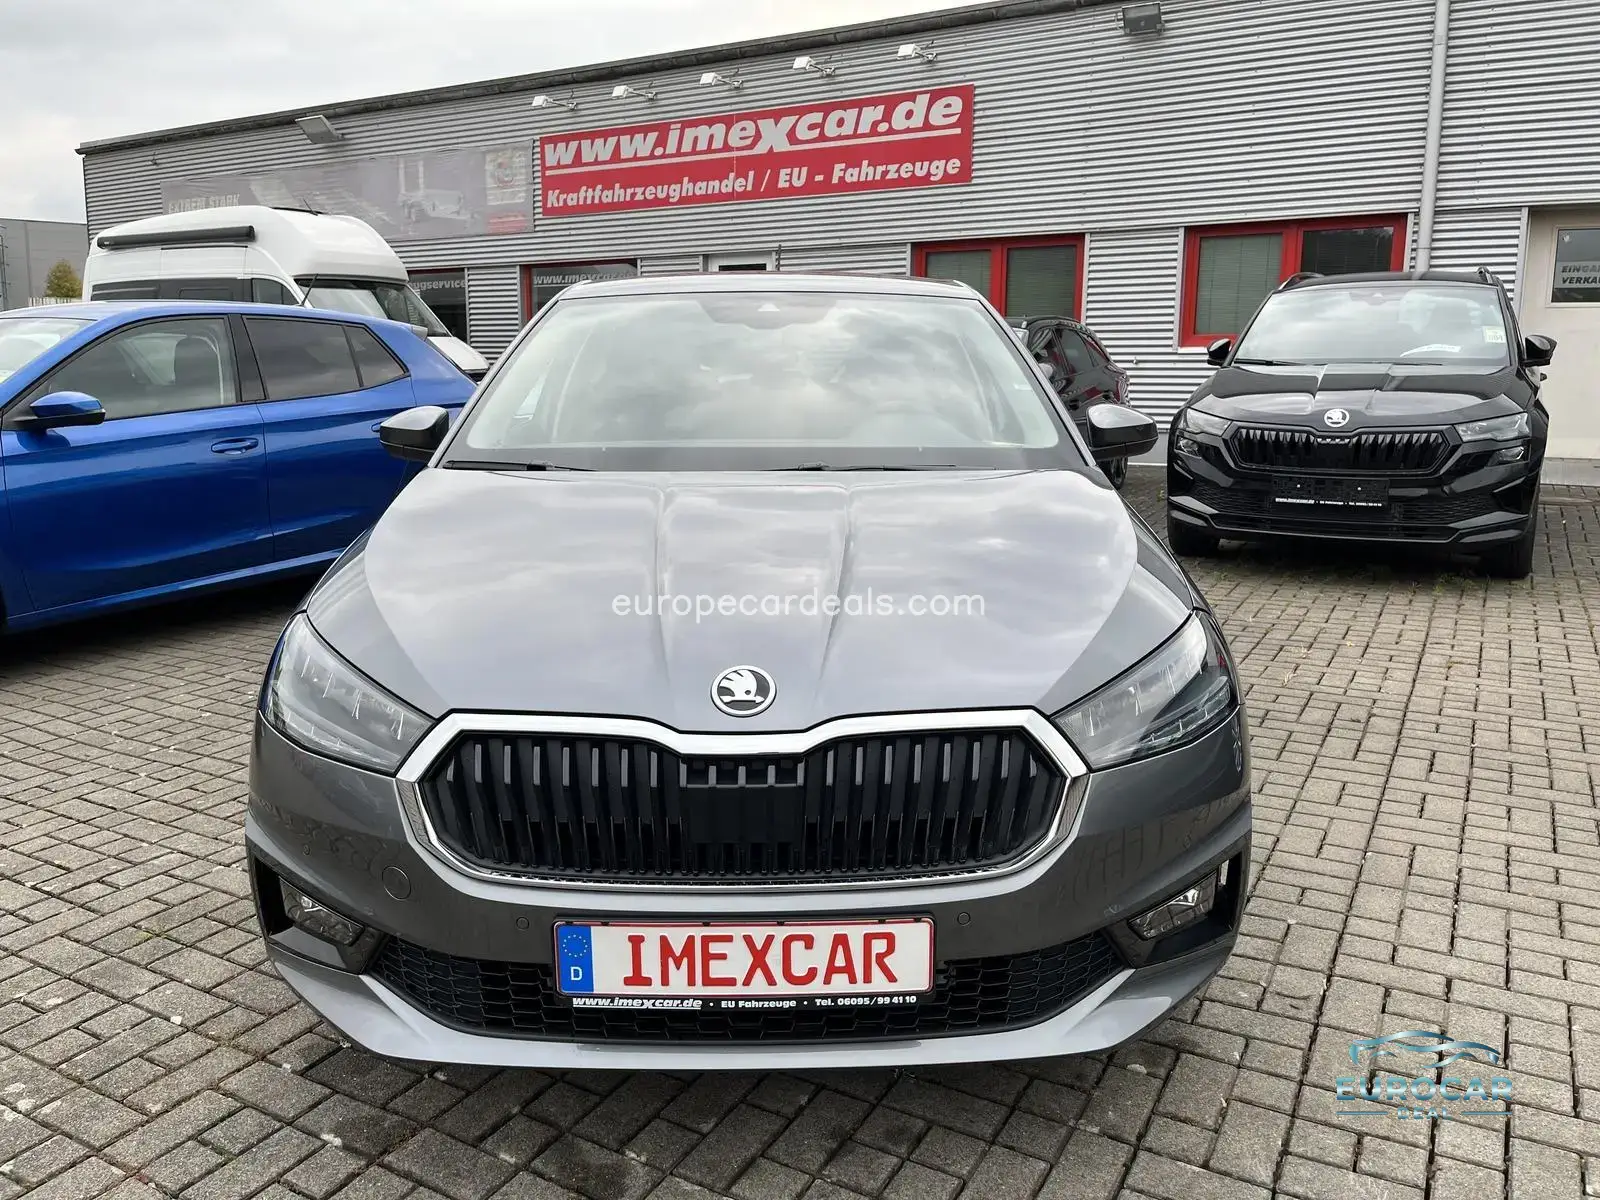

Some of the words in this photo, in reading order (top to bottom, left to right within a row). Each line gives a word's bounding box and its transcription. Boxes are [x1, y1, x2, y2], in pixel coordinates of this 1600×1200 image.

[544, 93, 963, 167] www.imexcar.de
[547, 170, 754, 208] Kraftfahrzeughandel
[760, 169, 771, 192] /
[777, 166, 808, 188] EU
[831, 157, 961, 184] Fahrzeuge
[1562, 265, 1600, 273] EINGA
[1562, 276, 1600, 284] VERKA
[570, 966, 583, 981] D
[623, 931, 898, 987] IMEXCAR
[572, 997, 702, 1009] www.imexcar.de
[721, 1000, 735, 1008] EU
[738, 1000, 797, 1008] Fahrzeuge
[815, 998, 834, 1006] Tel.
